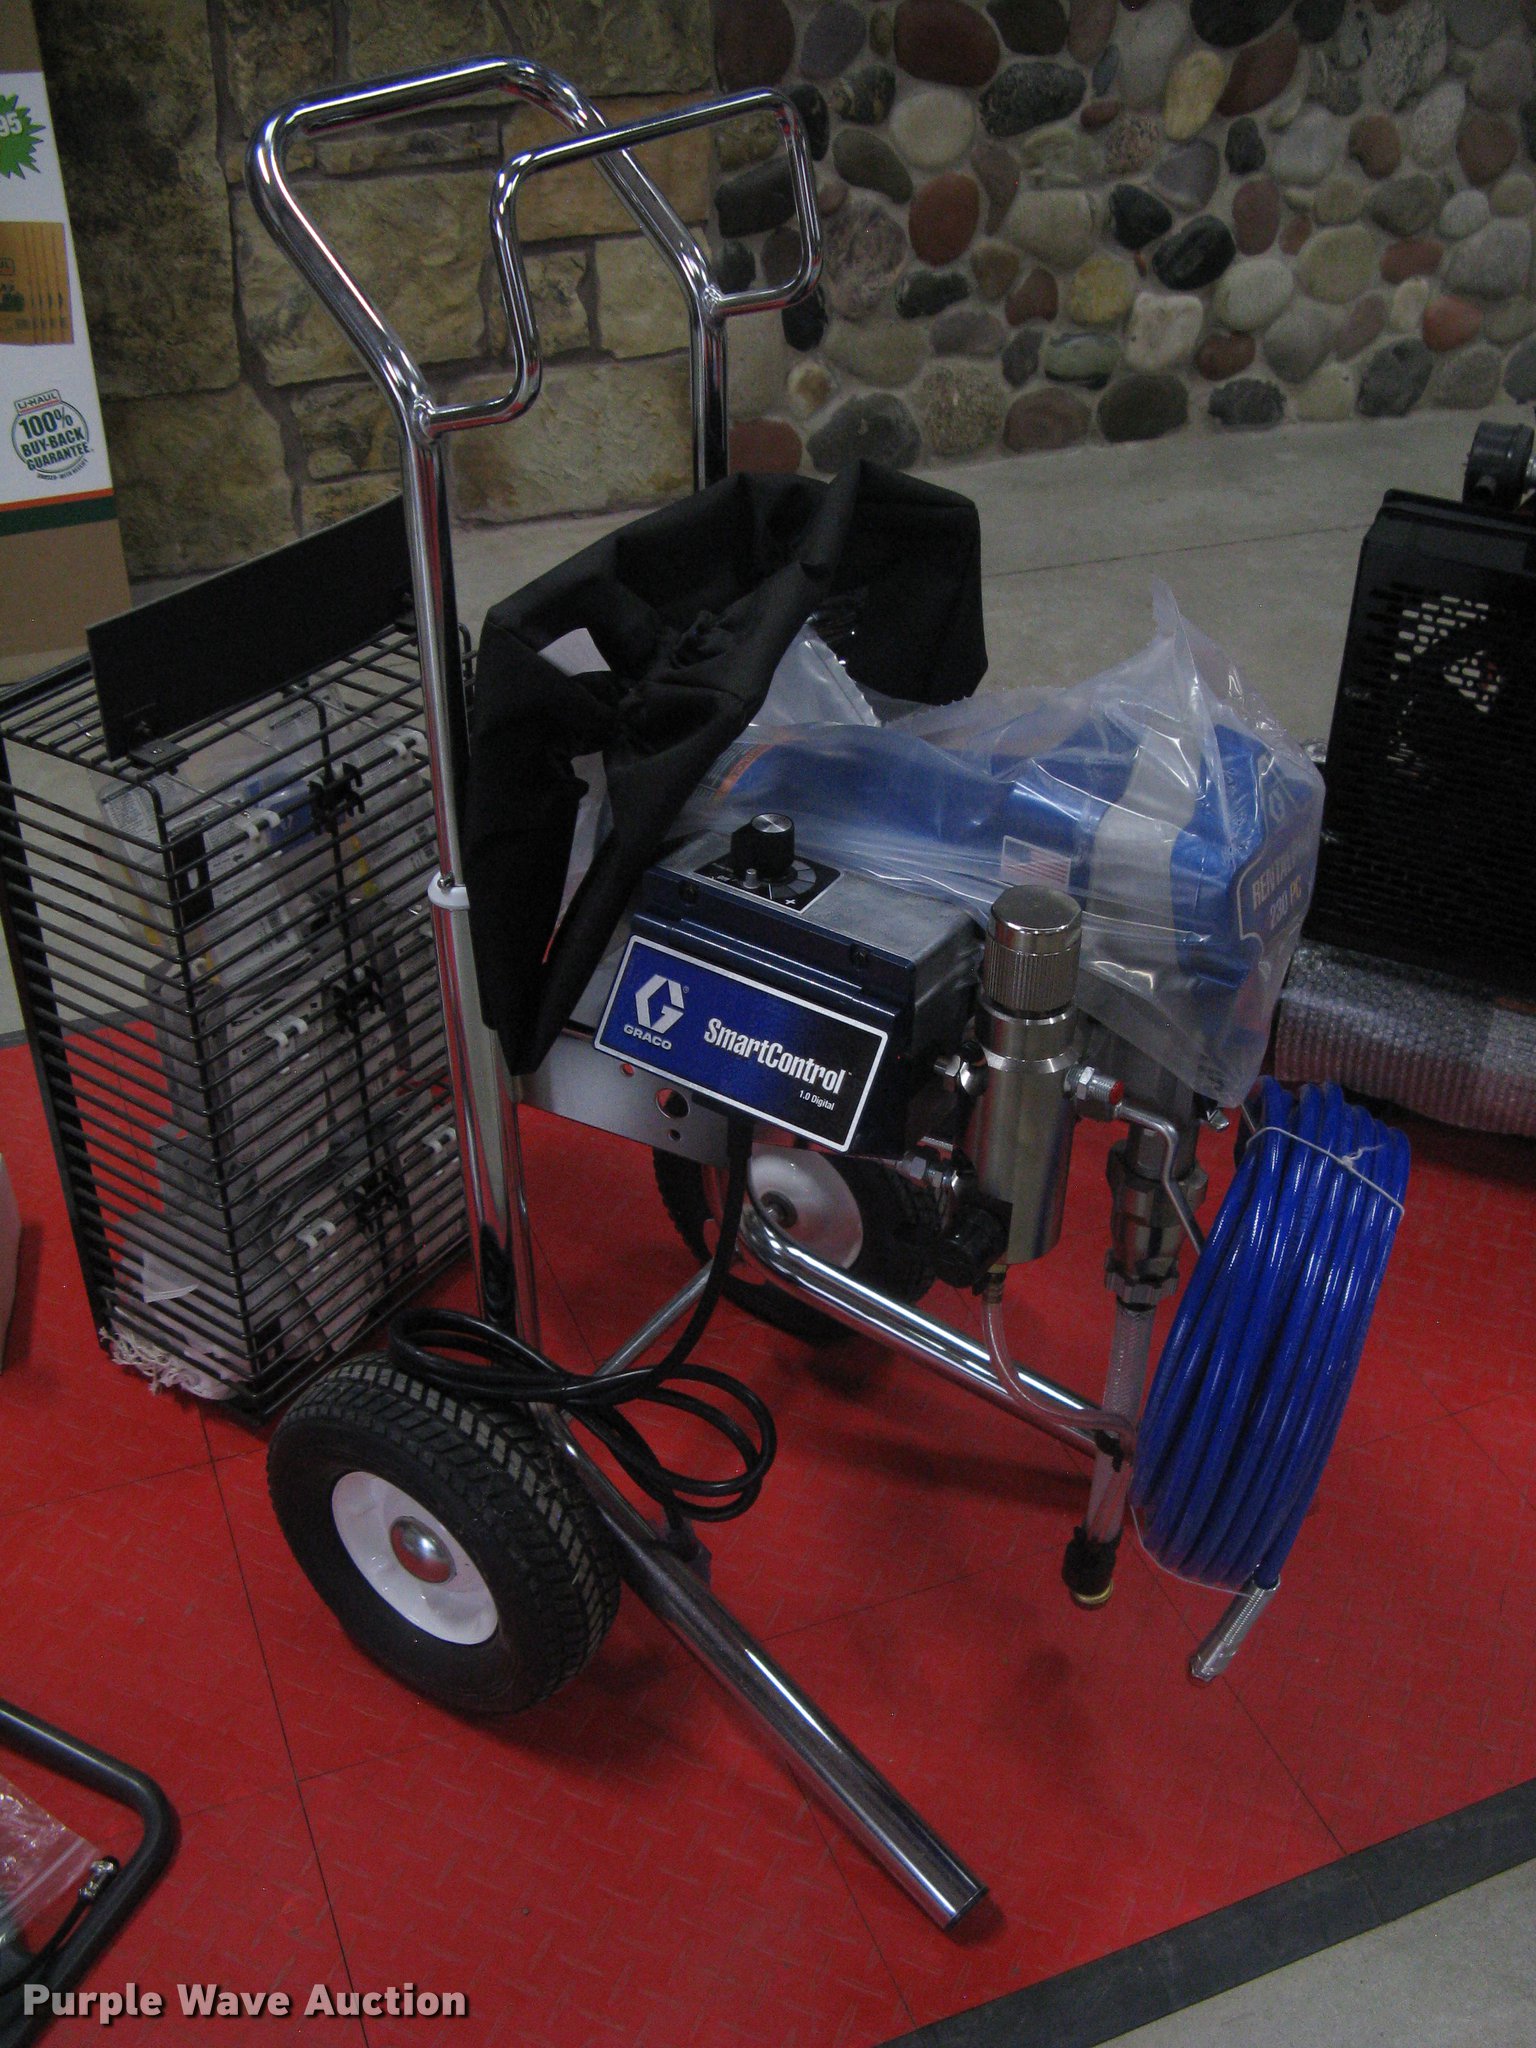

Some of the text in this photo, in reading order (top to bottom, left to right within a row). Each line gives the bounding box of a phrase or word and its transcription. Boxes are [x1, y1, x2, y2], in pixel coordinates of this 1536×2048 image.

[18, 406, 74, 439] 100%
[21, 427, 85, 457] BUY-BACK
[26, 442, 90, 471] GUARANTEE
[623, 1023, 672, 1051] GRACO
[703, 1017, 846, 1095] SmartControl
[799, 1089, 835, 1111] 1.0 Digital
